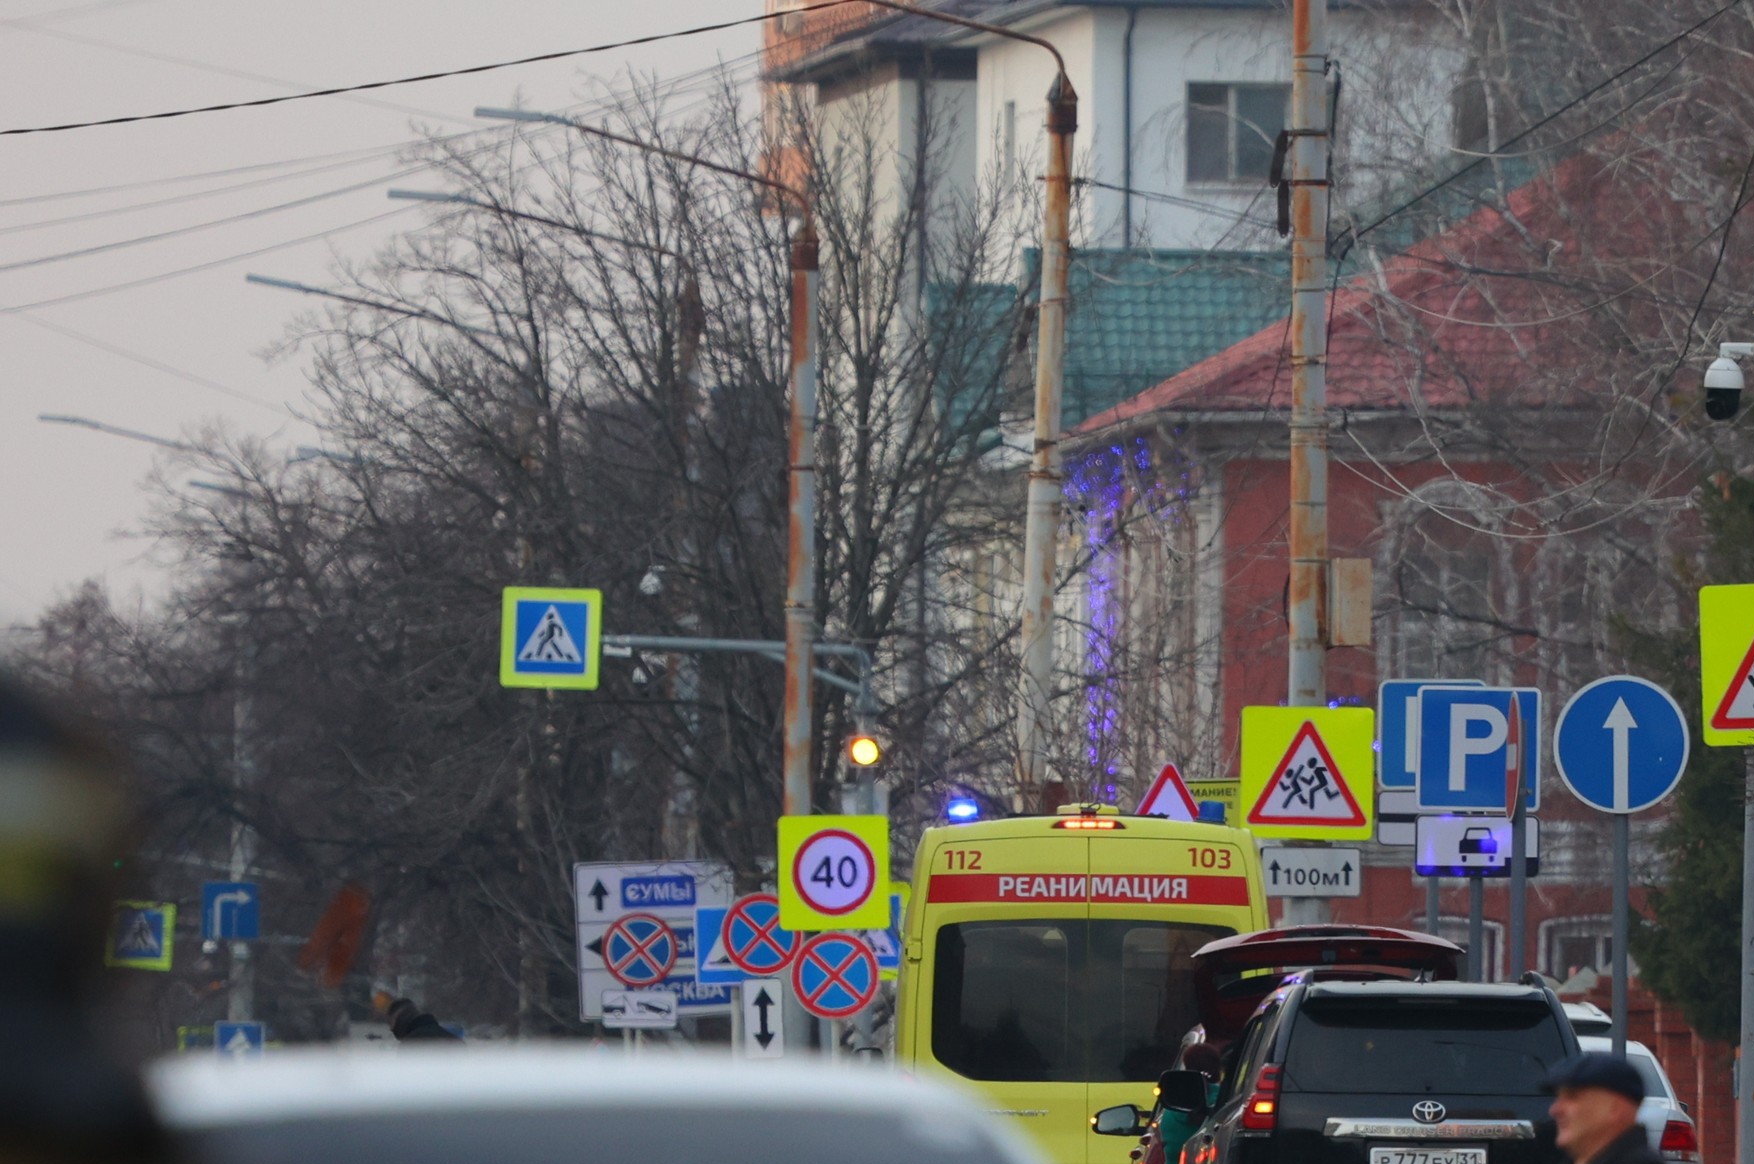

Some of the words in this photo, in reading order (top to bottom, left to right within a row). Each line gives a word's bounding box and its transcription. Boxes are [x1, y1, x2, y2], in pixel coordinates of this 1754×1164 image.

[1448, 703, 1508, 792] P
[944, 850, 982, 870] 112
[1188, 847, 1231, 869] 103
[810, 855, 858, 889] 40
[998, 876, 1188, 902] РЕАНИМАЦИЯ
